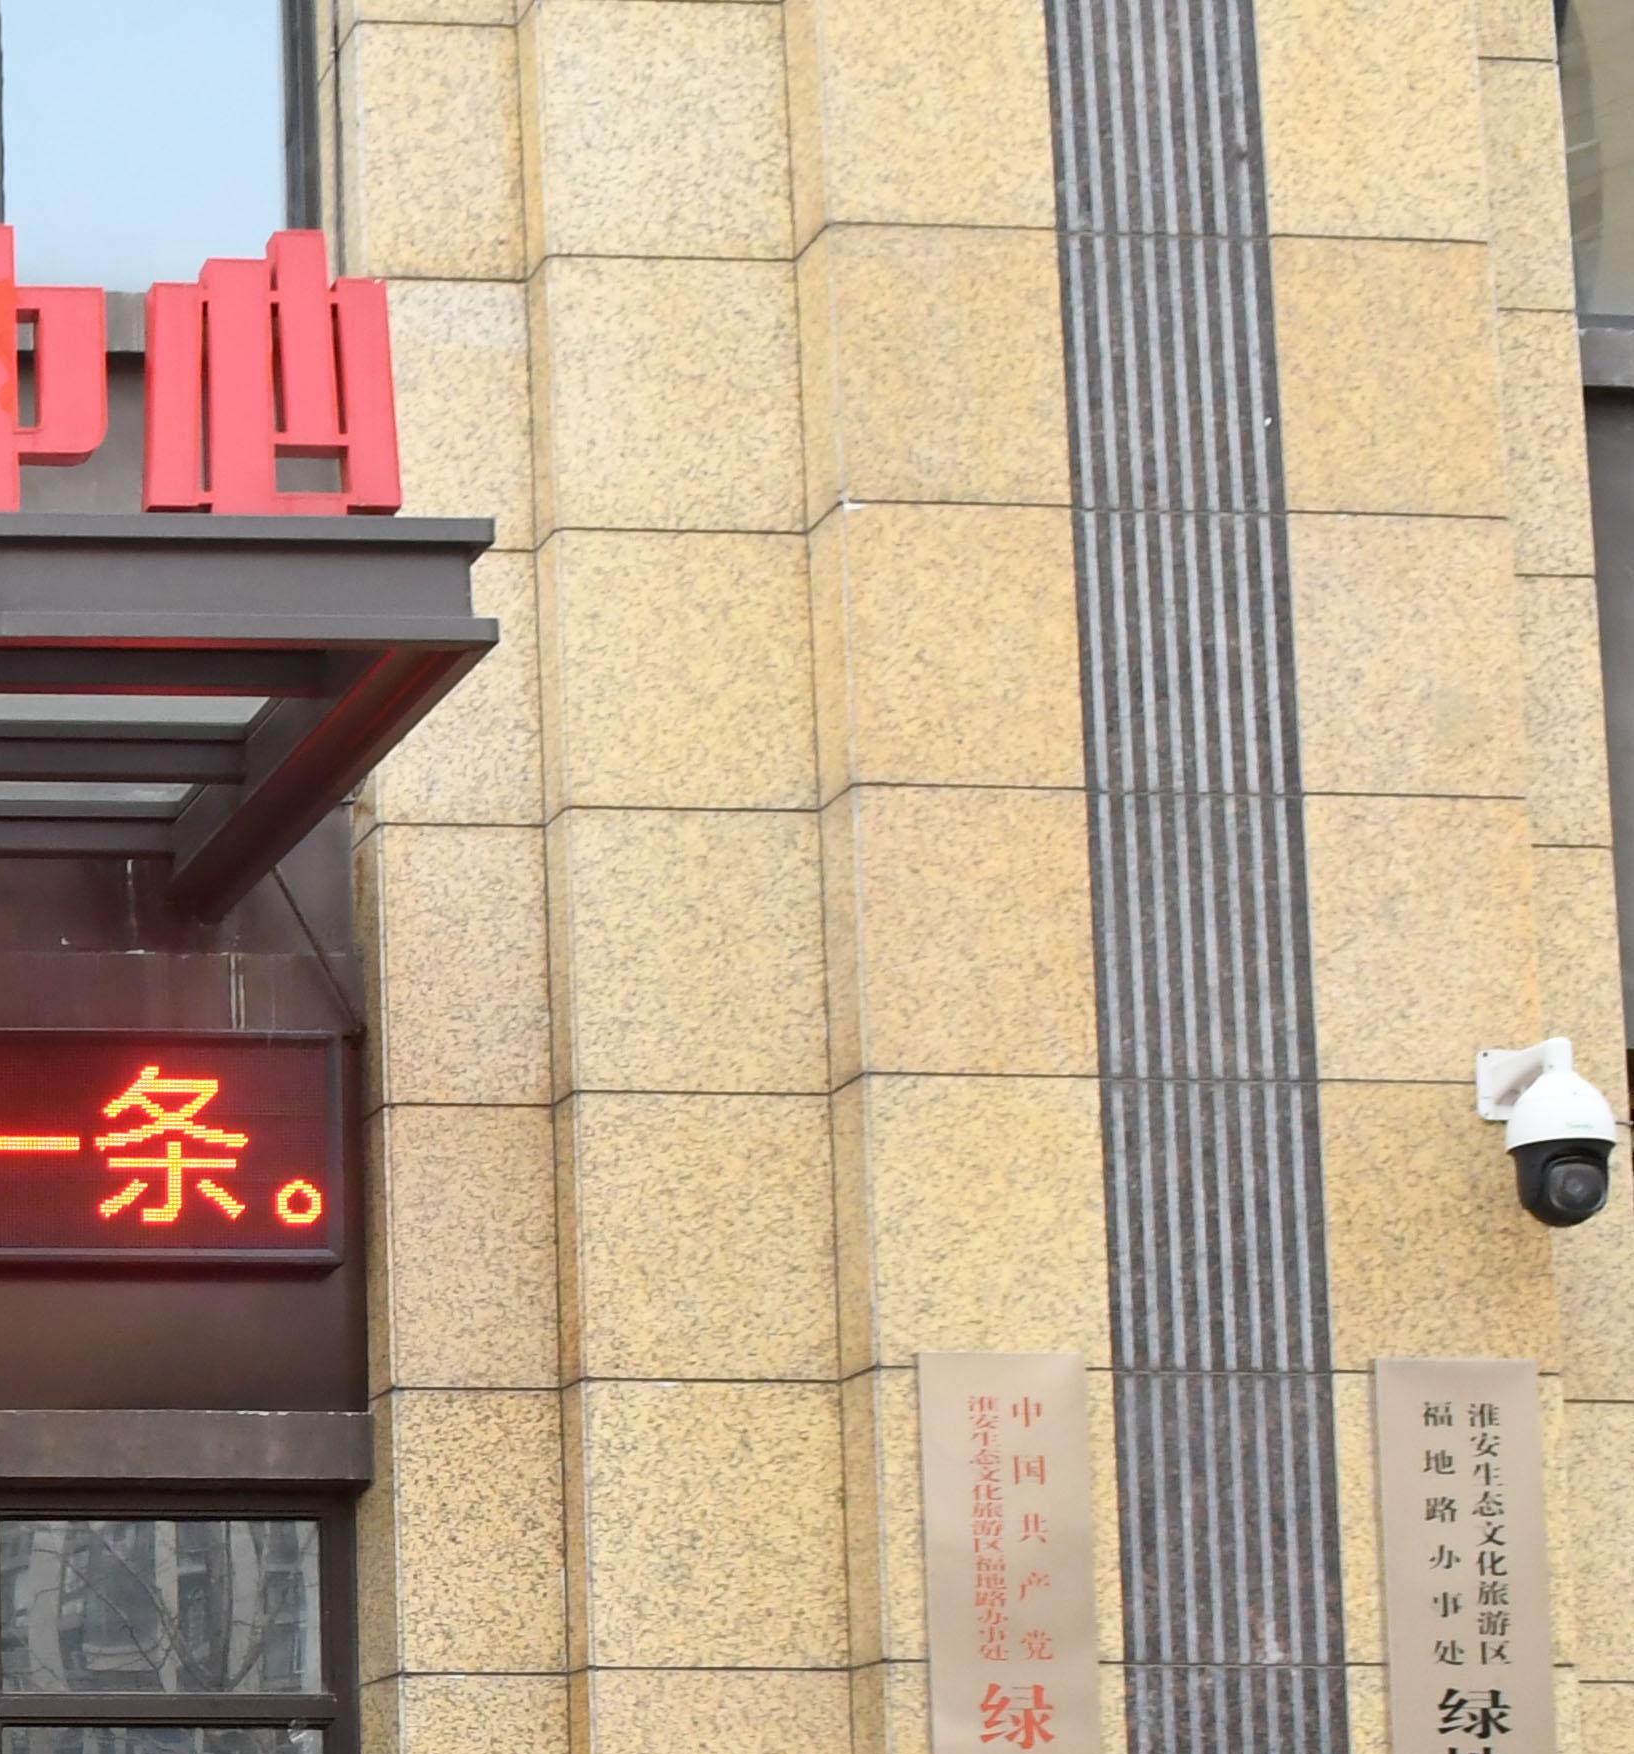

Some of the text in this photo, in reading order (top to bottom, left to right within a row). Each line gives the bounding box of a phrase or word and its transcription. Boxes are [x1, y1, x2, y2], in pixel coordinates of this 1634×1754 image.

[1010, 1395, 1053, 1661] 中国共产党
[1421, 1400, 1465, 1666] 福地路办事处
[1467, 1402, 1513, 1666] 淮安生态文化旅游区
